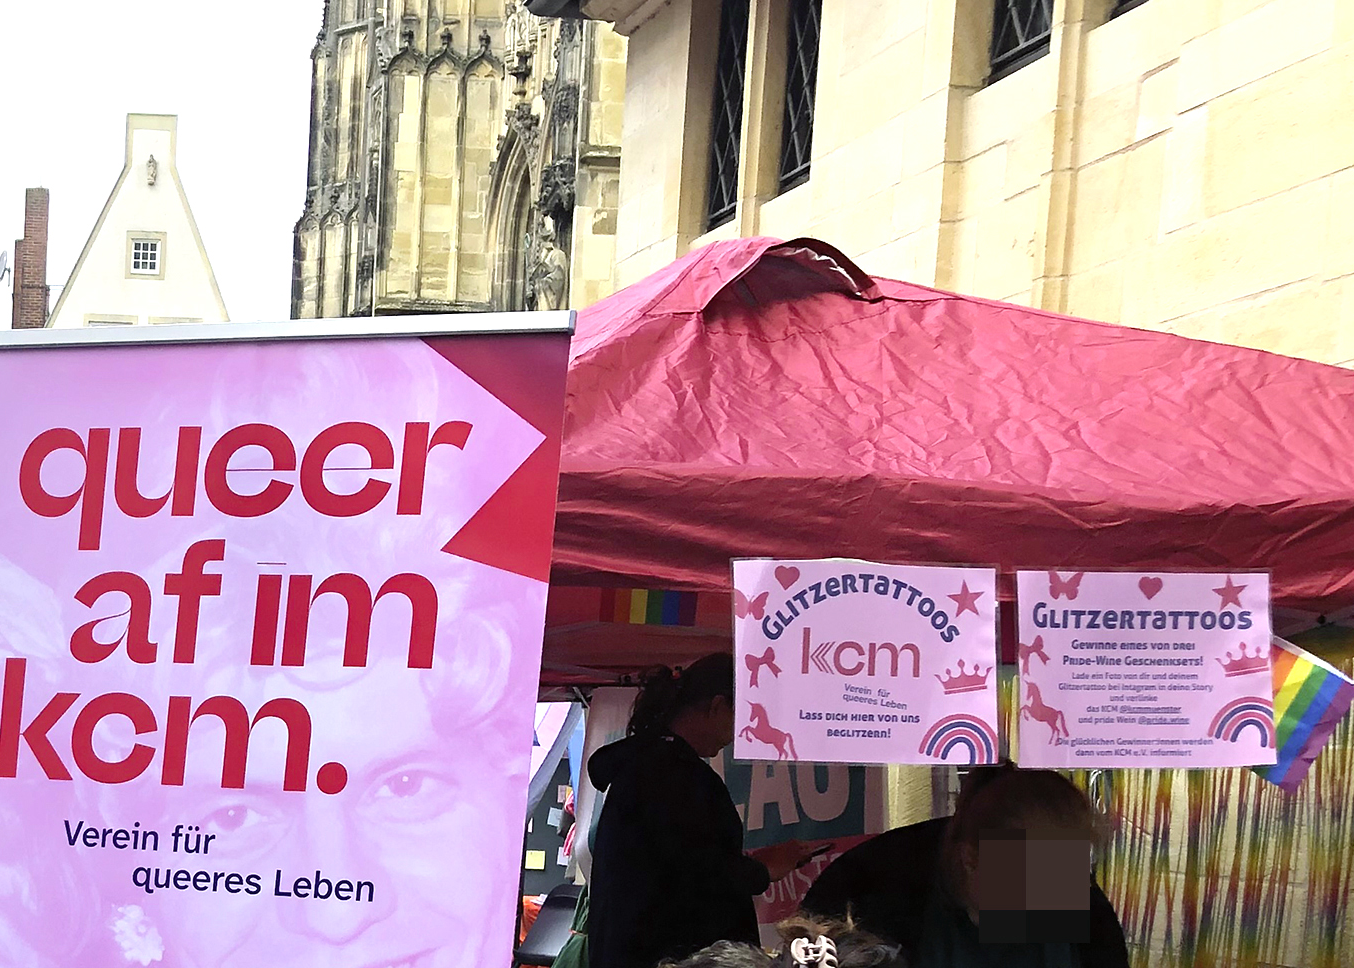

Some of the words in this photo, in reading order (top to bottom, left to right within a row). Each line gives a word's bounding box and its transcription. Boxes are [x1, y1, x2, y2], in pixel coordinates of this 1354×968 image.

[19, 420, 474, 551] queer
[69, 538, 226, 665] af
[249, 561, 439, 669] im
[801, 627, 921, 678] kcm
[844, 683, 872, 696] Verein
[877, 688, 891, 699] für
[1071, 672, 1090, 680] Lade
[1105, 672, 1122, 680] Foto
[1151, 672, 1167, 680] und
[1168, 672, 1199, 680] deinem
[1191, 683, 1214, 693] Story
[842, 693, 878, 706] queeres
[879, 698, 908, 711] Leben
[63, 819, 160, 852] Verein
[171, 825, 216, 855] für
[132, 866, 263, 895] queeres
[274, 869, 375, 903] Leben
